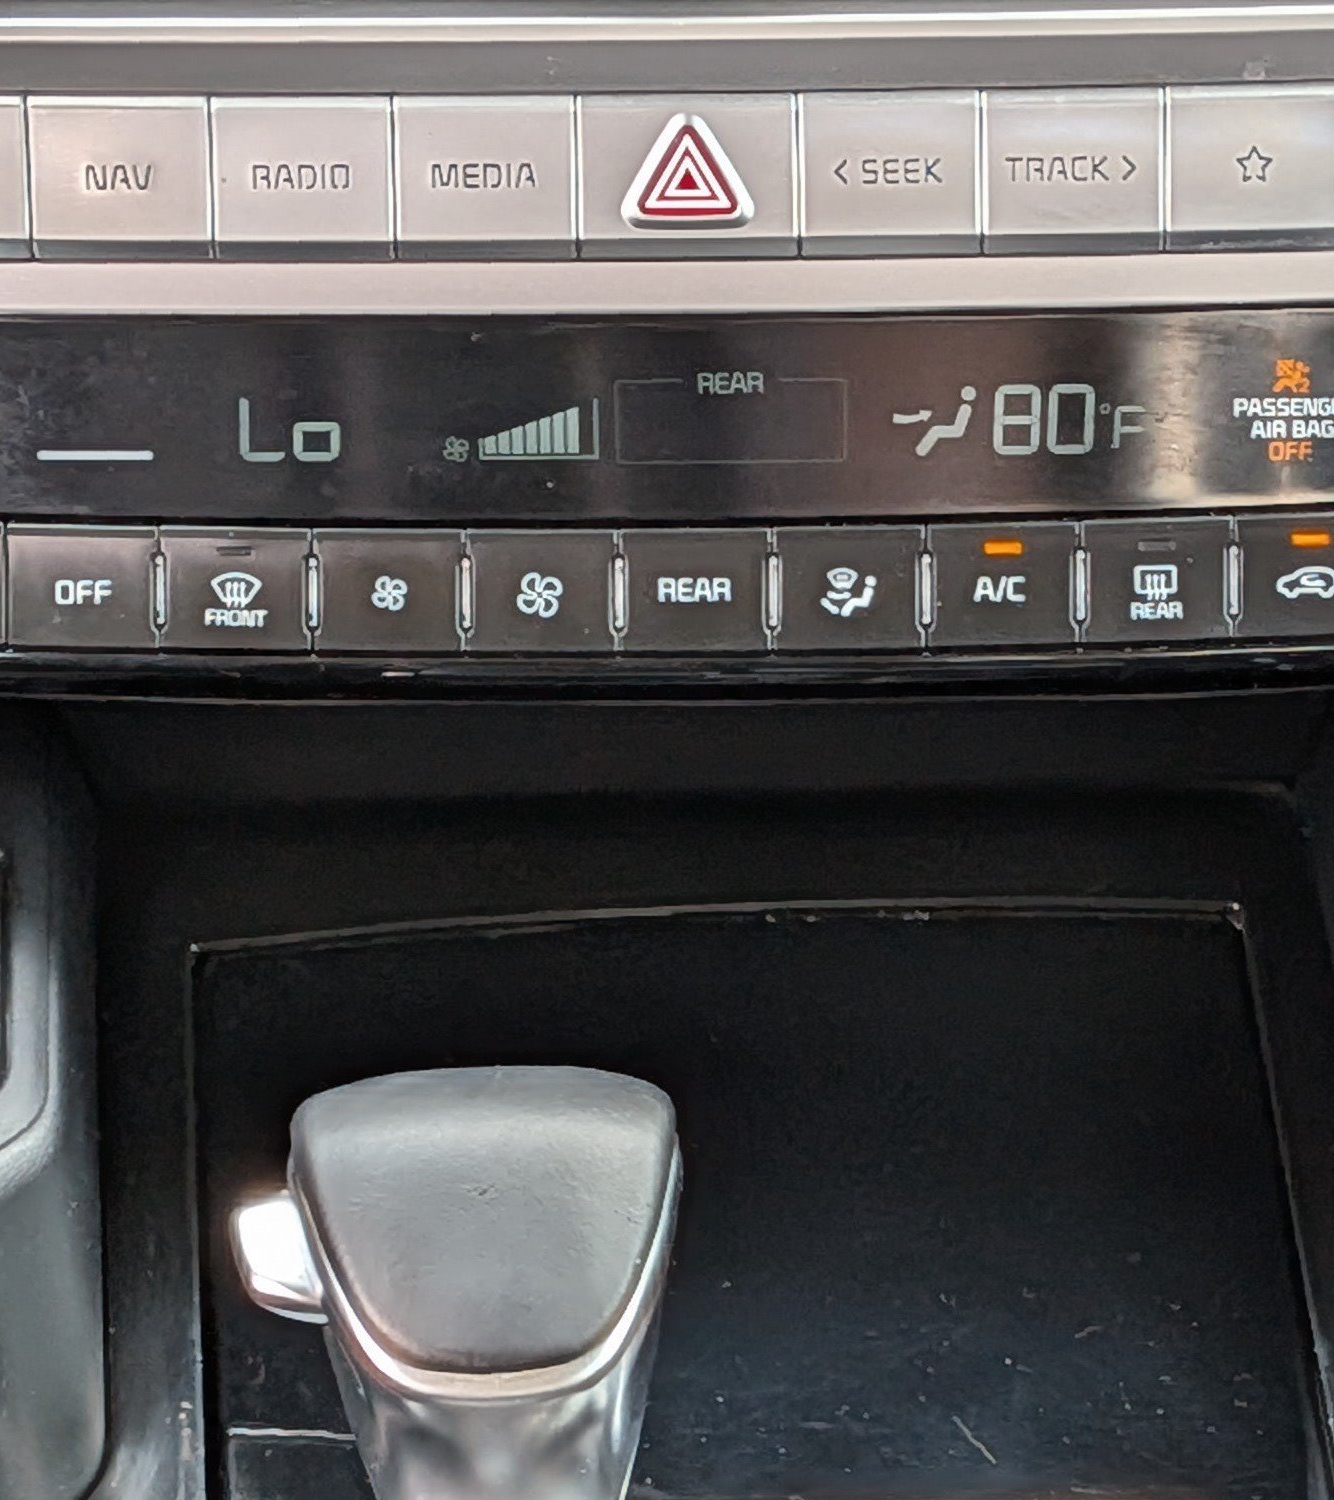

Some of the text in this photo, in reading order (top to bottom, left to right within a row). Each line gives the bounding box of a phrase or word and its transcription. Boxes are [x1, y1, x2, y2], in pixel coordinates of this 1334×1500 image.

[84, 163, 154, 192] NAV
[251, 162, 352, 191] RADIO
[430, 161, 539, 190] MEDIA
[861, 157, 944, 185] SEEK
[1005, 155, 1111, 184] TRACK
[696, 371, 766, 396] REAR
[1249, 419, 1288, 440] AIR
[1267, 440, 1313, 462] OFF
[54, 578, 113, 607] OFF
[657, 577, 732, 604] REAR
[973, 576, 1027, 604] A/C
[203, 608, 268, 629] FRONT
[1129, 600, 1184, 621] REAR
